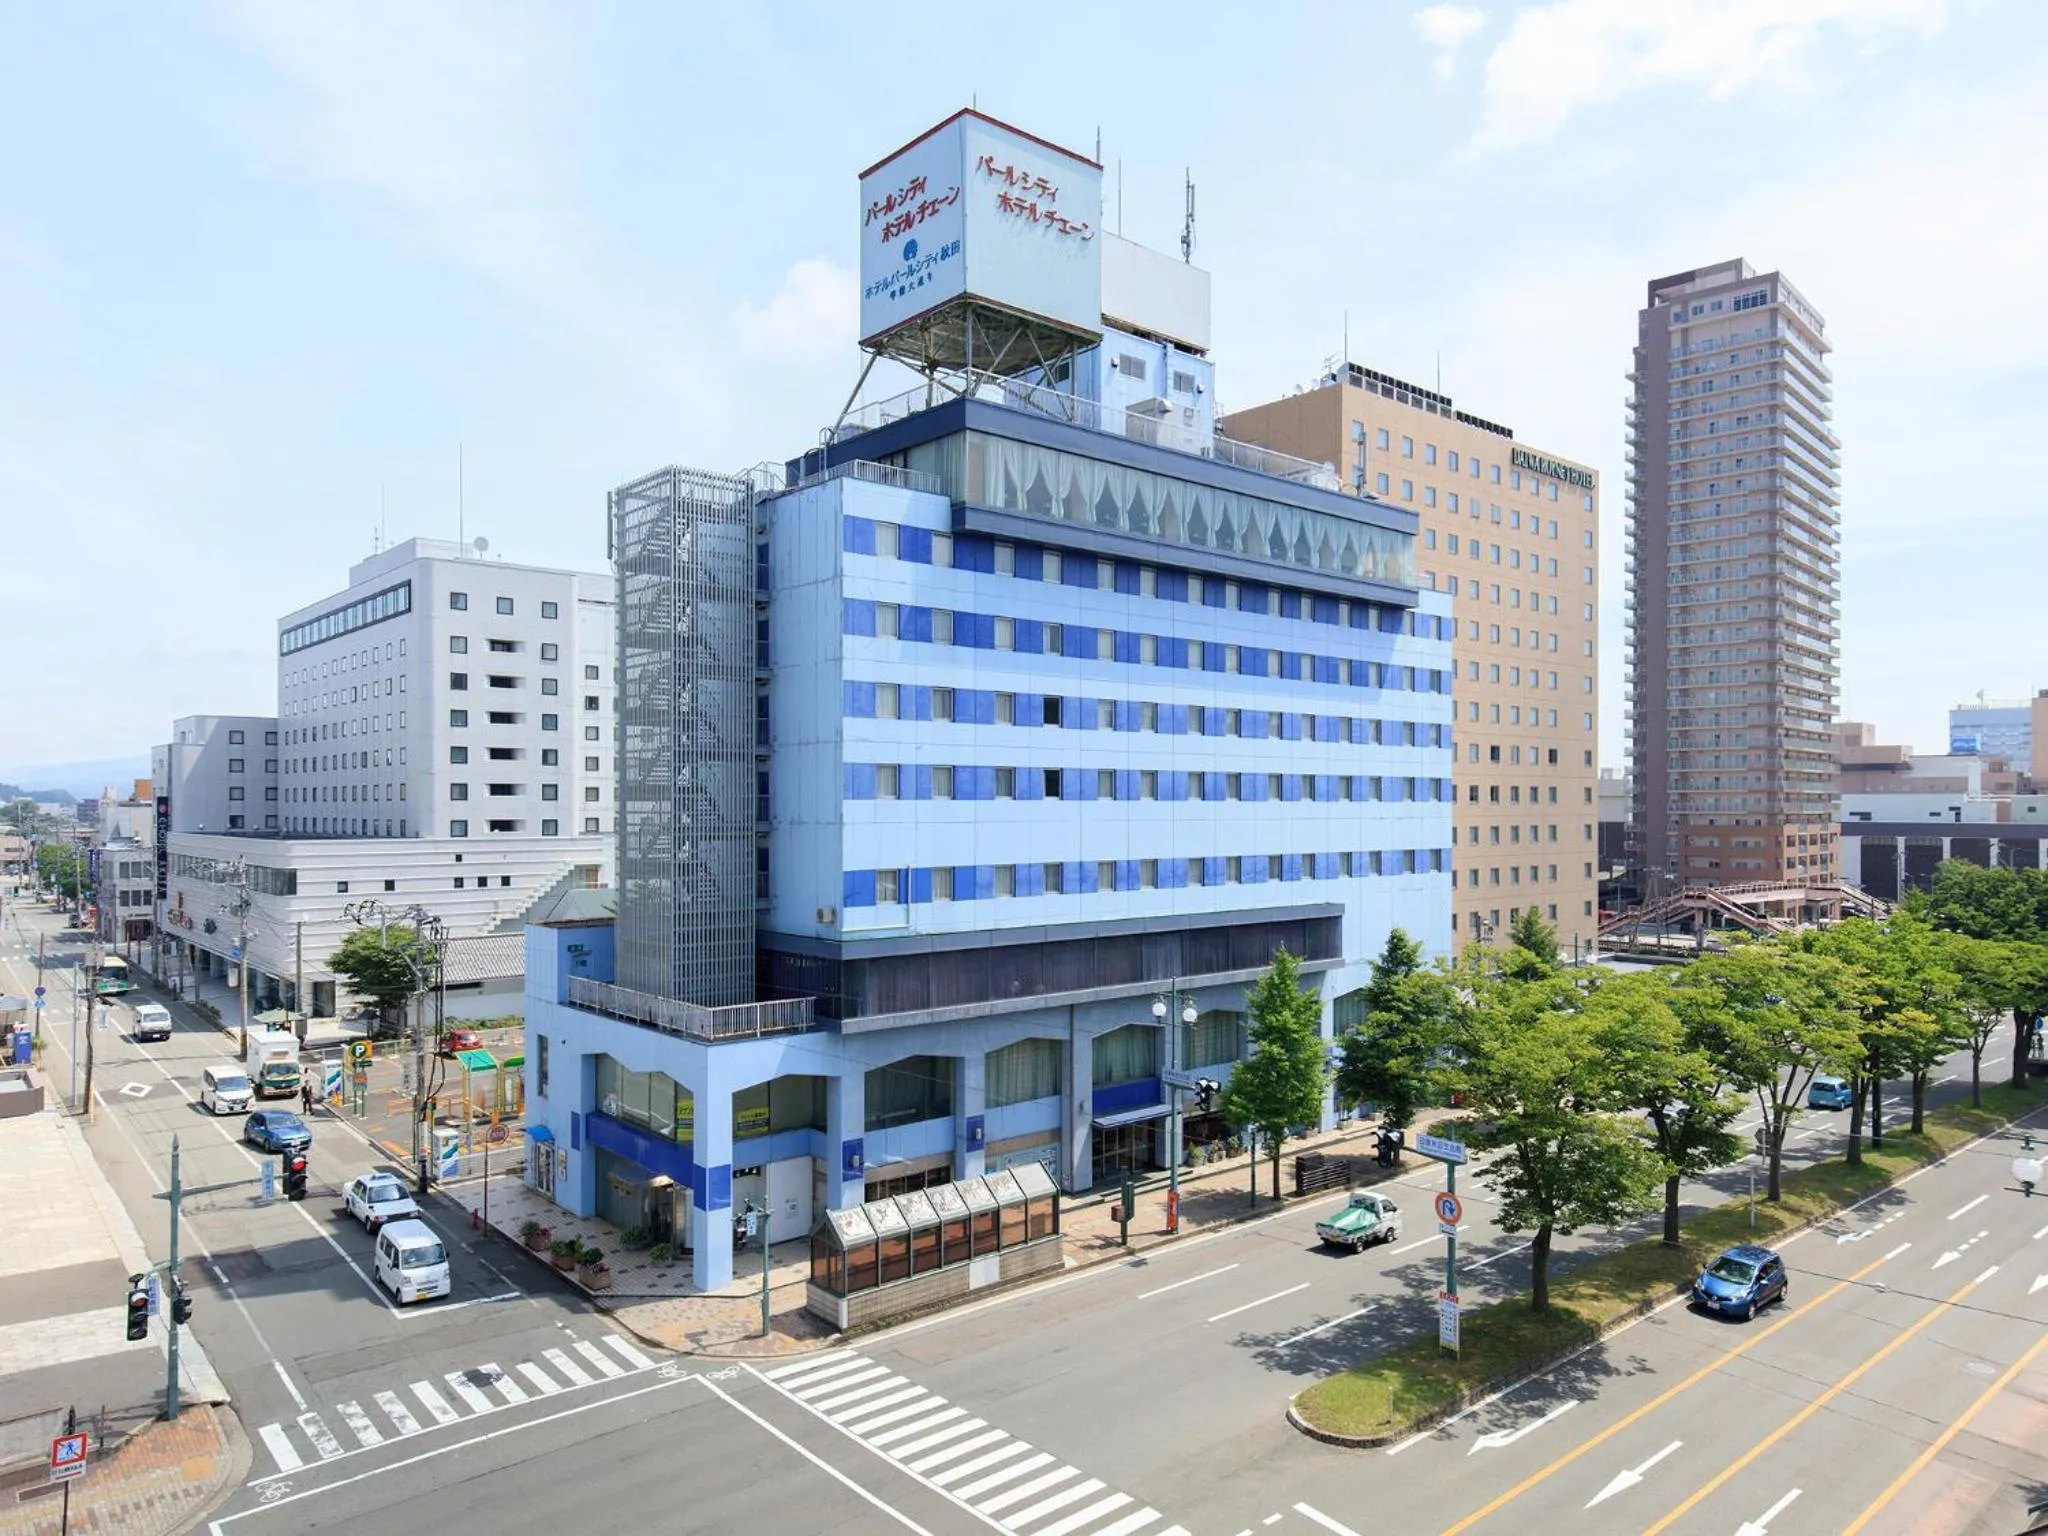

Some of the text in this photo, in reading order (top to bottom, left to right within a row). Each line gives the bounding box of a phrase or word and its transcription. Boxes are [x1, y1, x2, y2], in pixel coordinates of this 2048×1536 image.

[864, 176, 927, 227] パールシティ
[974, 155, 1059, 202] パールシティ
[880, 186, 960, 244] ホテルチェーン
[996, 191, 1095, 241] ホテルチェーン
[355, 1046, 365, 1057] P
